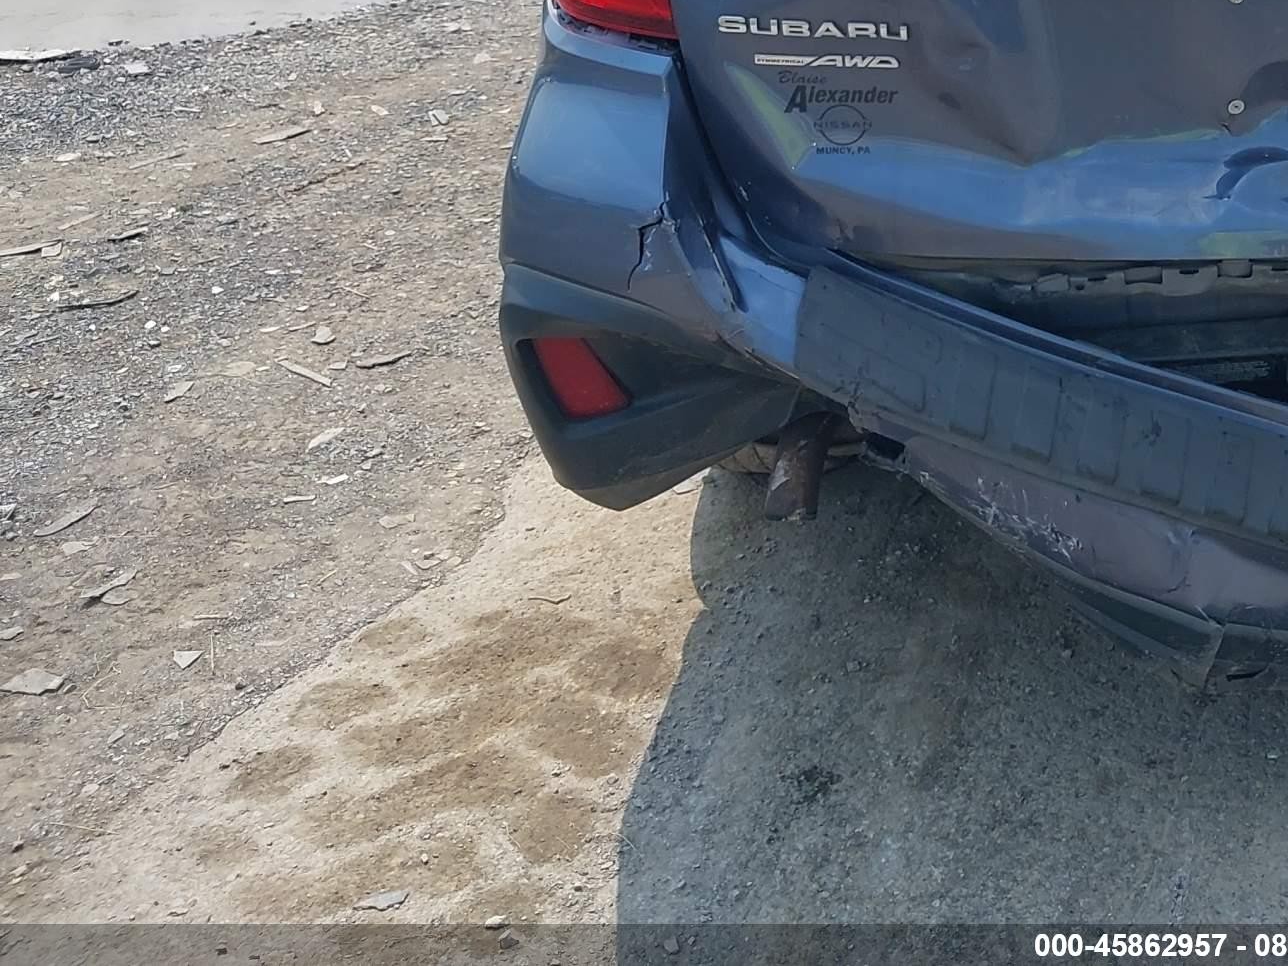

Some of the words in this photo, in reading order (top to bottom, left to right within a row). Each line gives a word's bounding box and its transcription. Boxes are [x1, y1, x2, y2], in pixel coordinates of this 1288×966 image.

[718, 15, 909, 42] SUBARU
[808, 53, 900, 69] AWD
[778, 69, 828, 85] Blaise
[784, 84, 899, 114] Alexander
[813, 120, 873, 132] NISSAN
[816, 146, 855, 156] MUNCY,
[857, 145, 871, 155] PA
